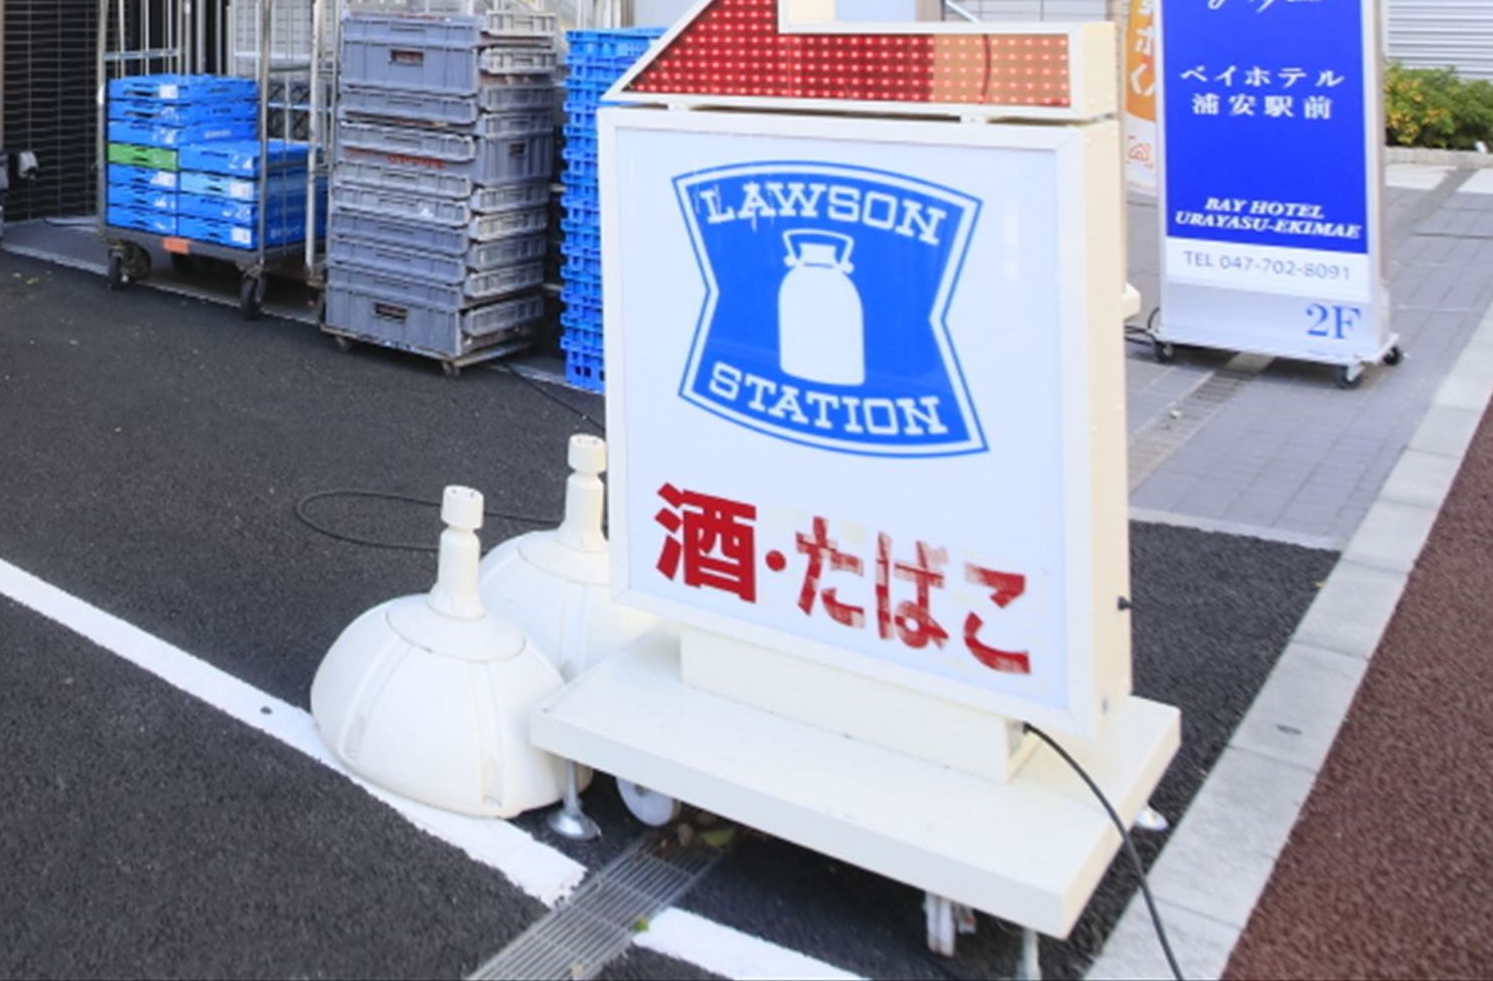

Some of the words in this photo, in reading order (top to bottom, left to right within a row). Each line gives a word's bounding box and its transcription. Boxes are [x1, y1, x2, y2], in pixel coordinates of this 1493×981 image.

[1180, 65, 1345, 88] ベイホテル
[1191, 93, 1334, 120] 浦安駅前
[700, 180, 947, 246] LAWSON
[1205, 196, 1246, 213] BAY
[1249, 200, 1325, 220] HOTEL
[1175, 210, 1361, 240] URAYASU-EKIMAE
[1184, 250, 1214, 268] TEL
[1219, 254, 1352, 281] 047-702-8091
[1306, 302, 1362, 340] 2F
[709, 361, 949, 436] STATION
[654, 481, 1032, 676] 酒・たばこ
